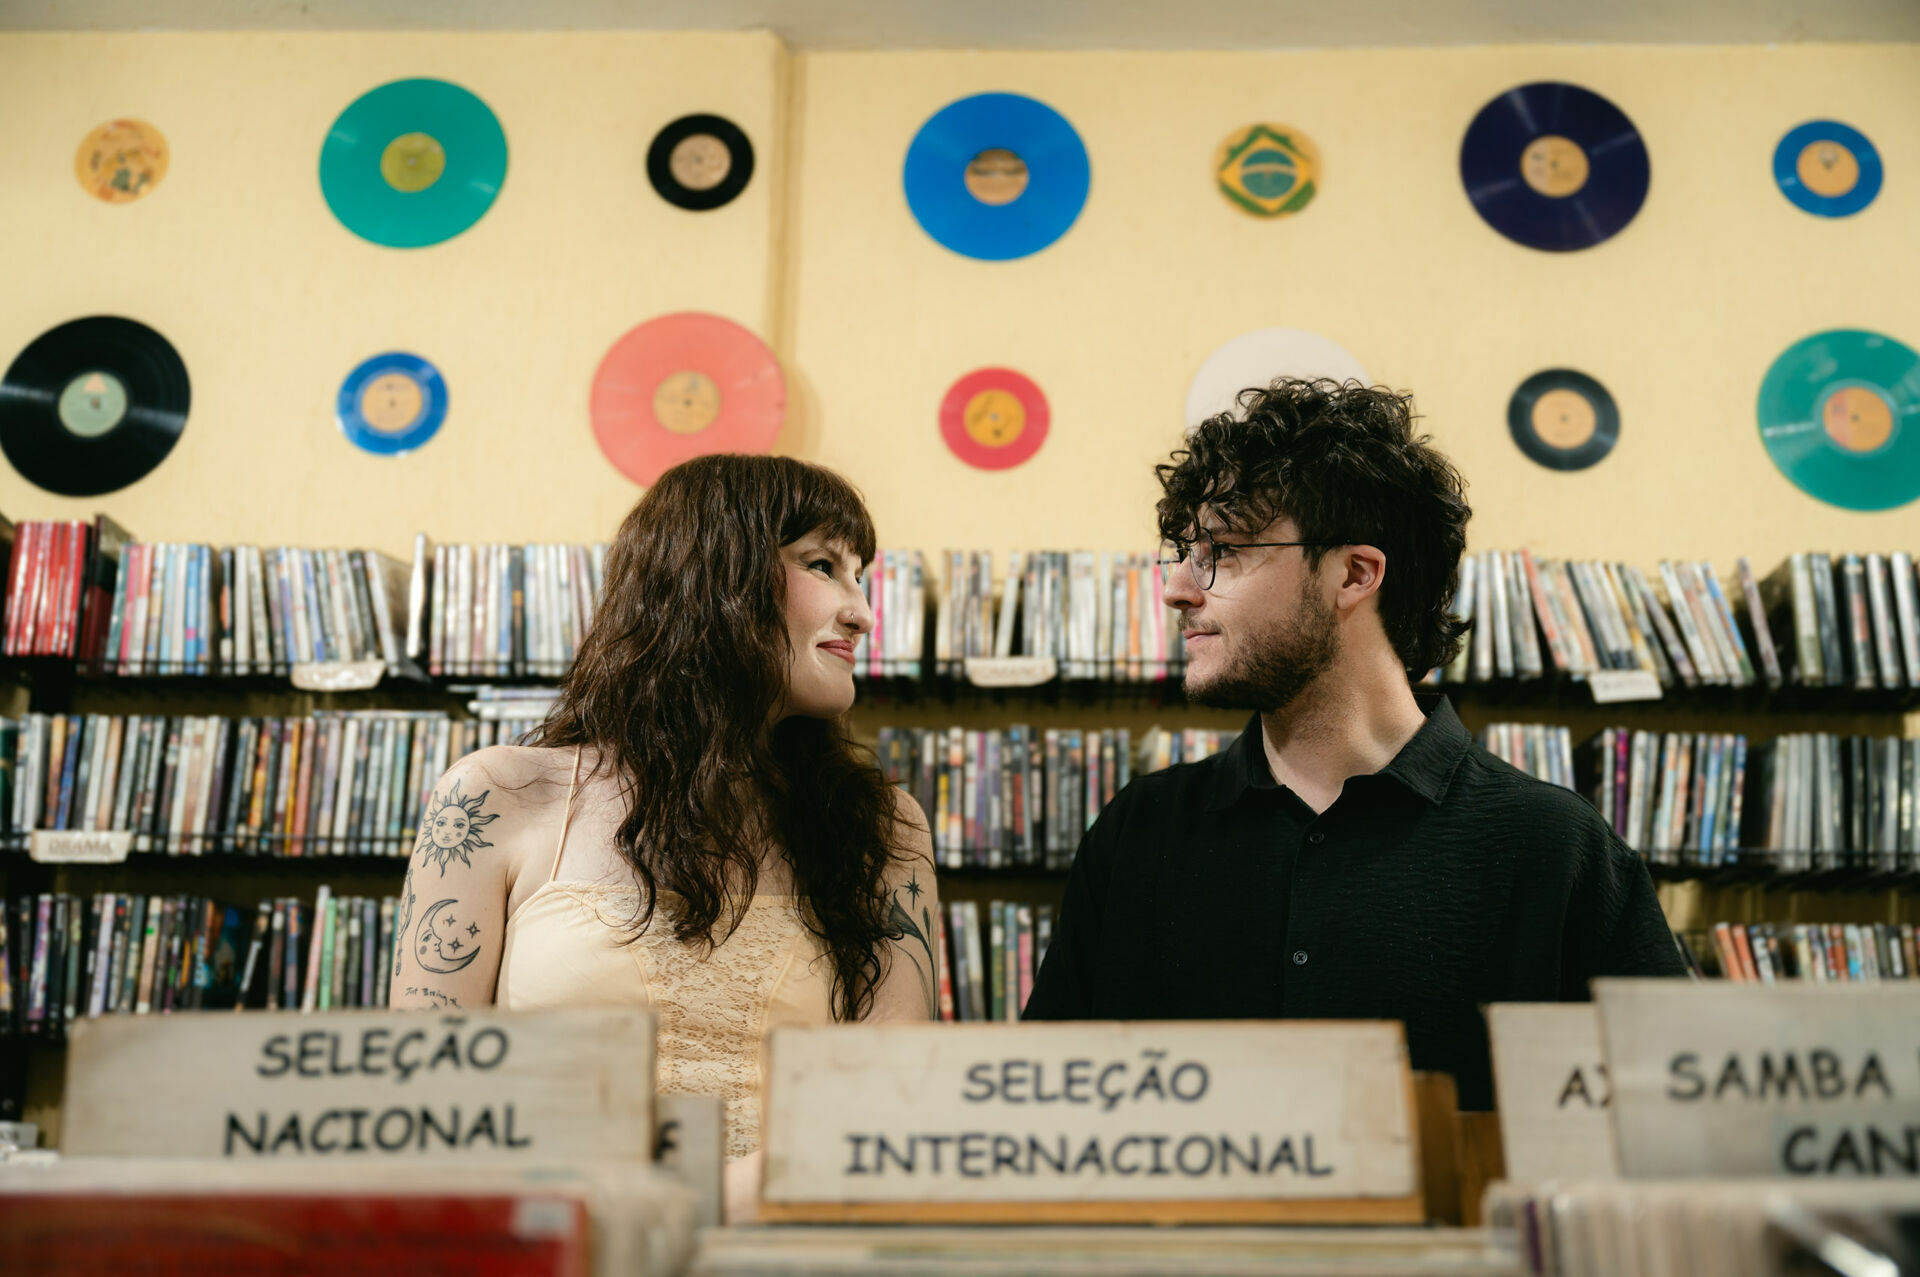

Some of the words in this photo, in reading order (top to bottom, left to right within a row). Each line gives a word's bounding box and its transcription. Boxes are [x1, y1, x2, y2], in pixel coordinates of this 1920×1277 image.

[257, 1015, 509, 1082] SELEÇÃO
[1668, 1048, 1892, 1100] SAMBA
[962, 1049, 1209, 1111] SELEÇÃO
[223, 1106, 531, 1157] NACIONAL
[845, 1132, 1333, 1178] INTERNACIONAL
[1781, 1124, 1920, 1177] CAN
